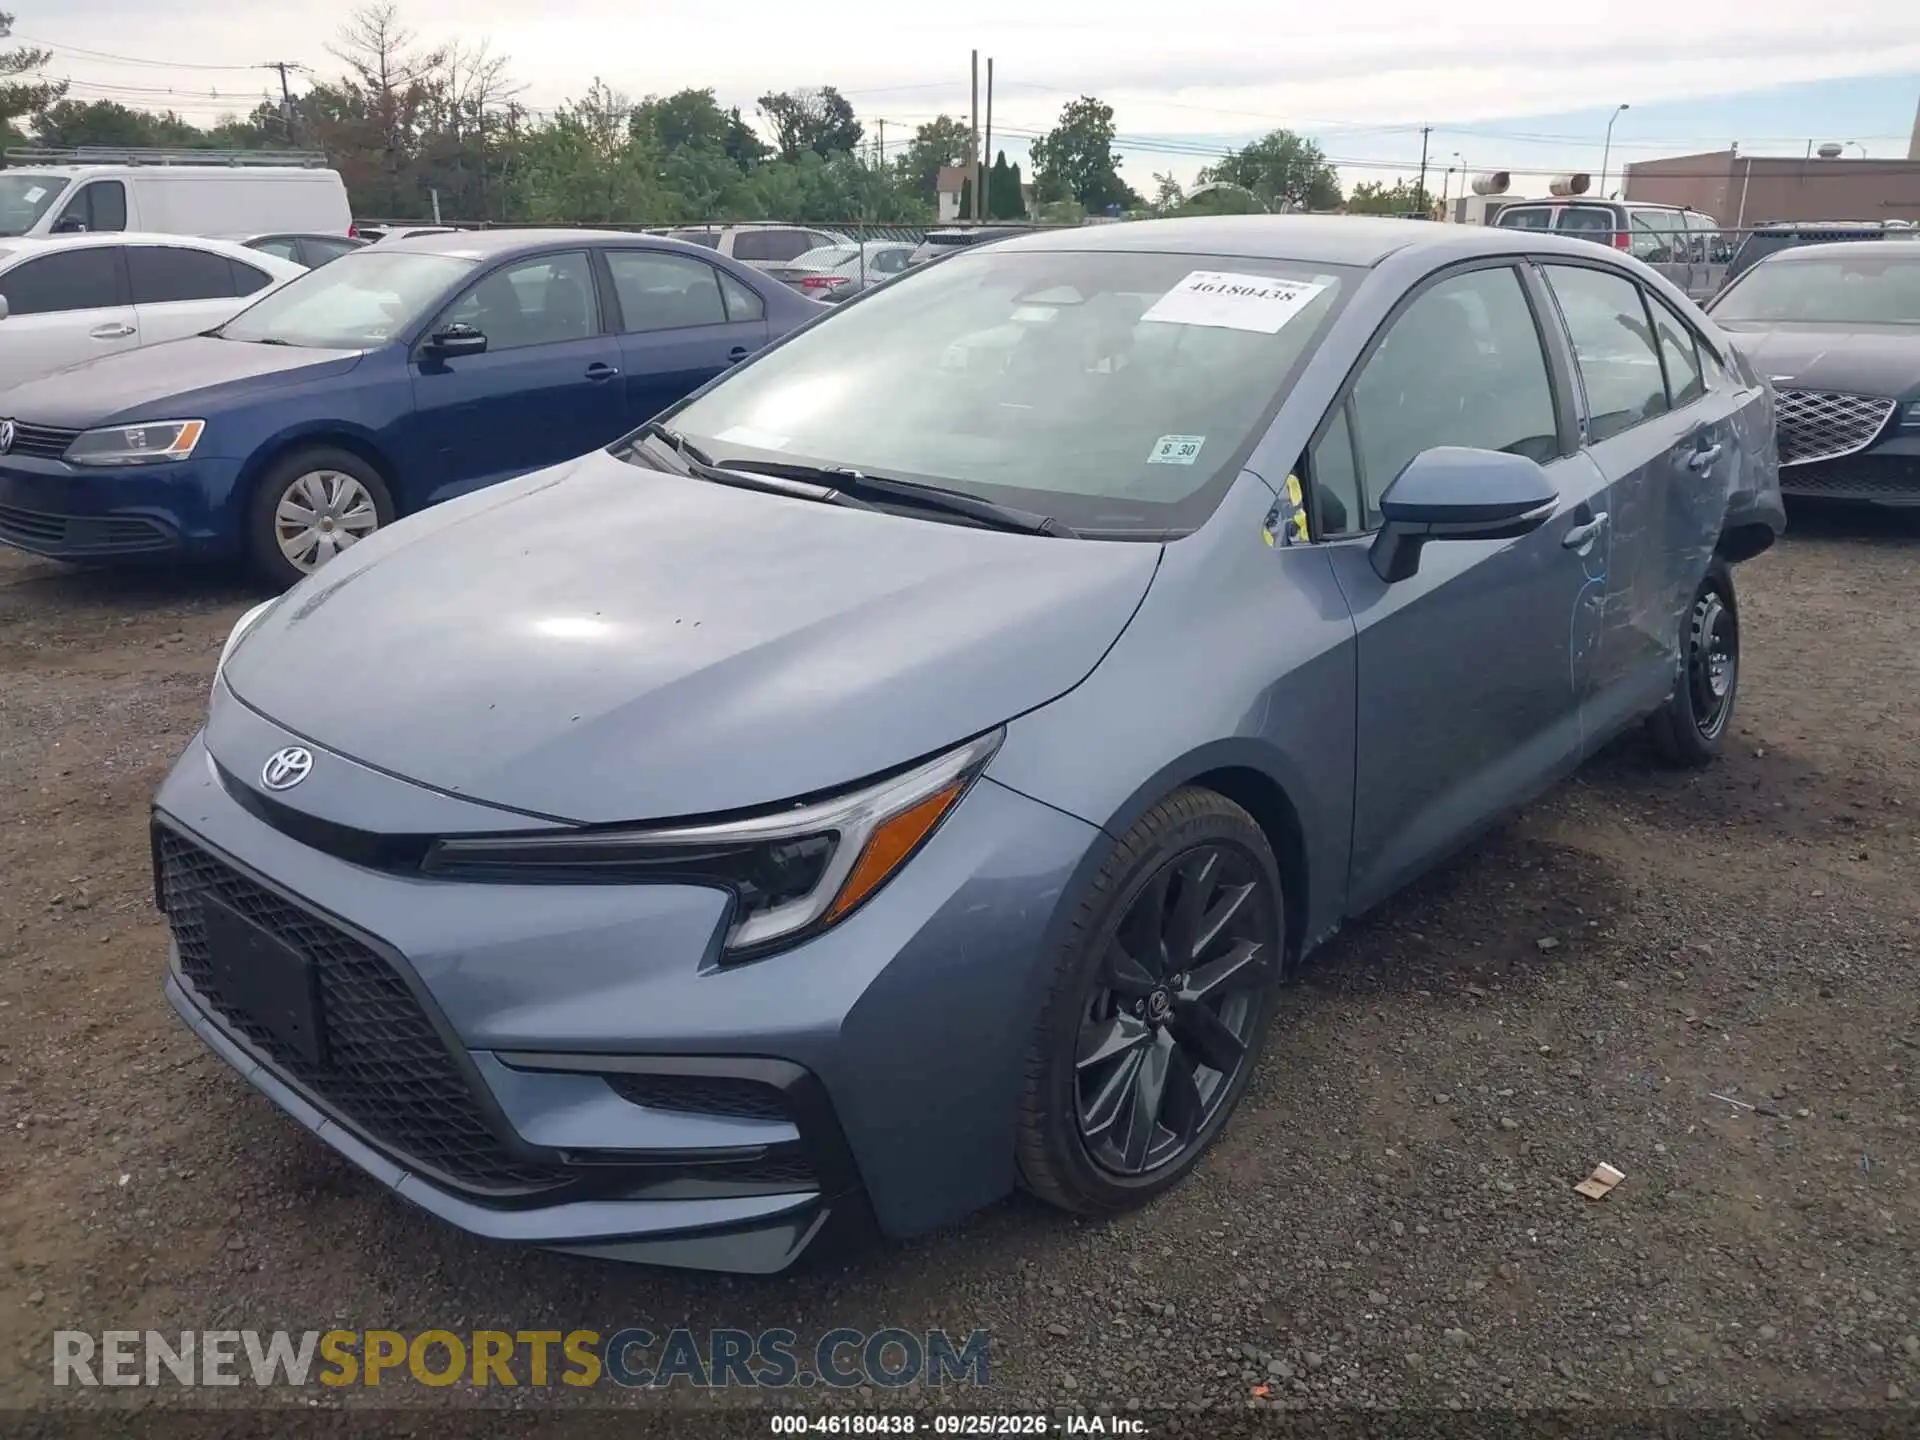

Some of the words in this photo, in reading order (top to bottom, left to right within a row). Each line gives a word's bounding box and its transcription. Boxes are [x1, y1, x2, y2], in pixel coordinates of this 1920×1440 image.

[1189, 282, 1297, 301] 46180438
[1161, 443, 1172, 455] 8
[1177, 443, 1196, 456] 30
